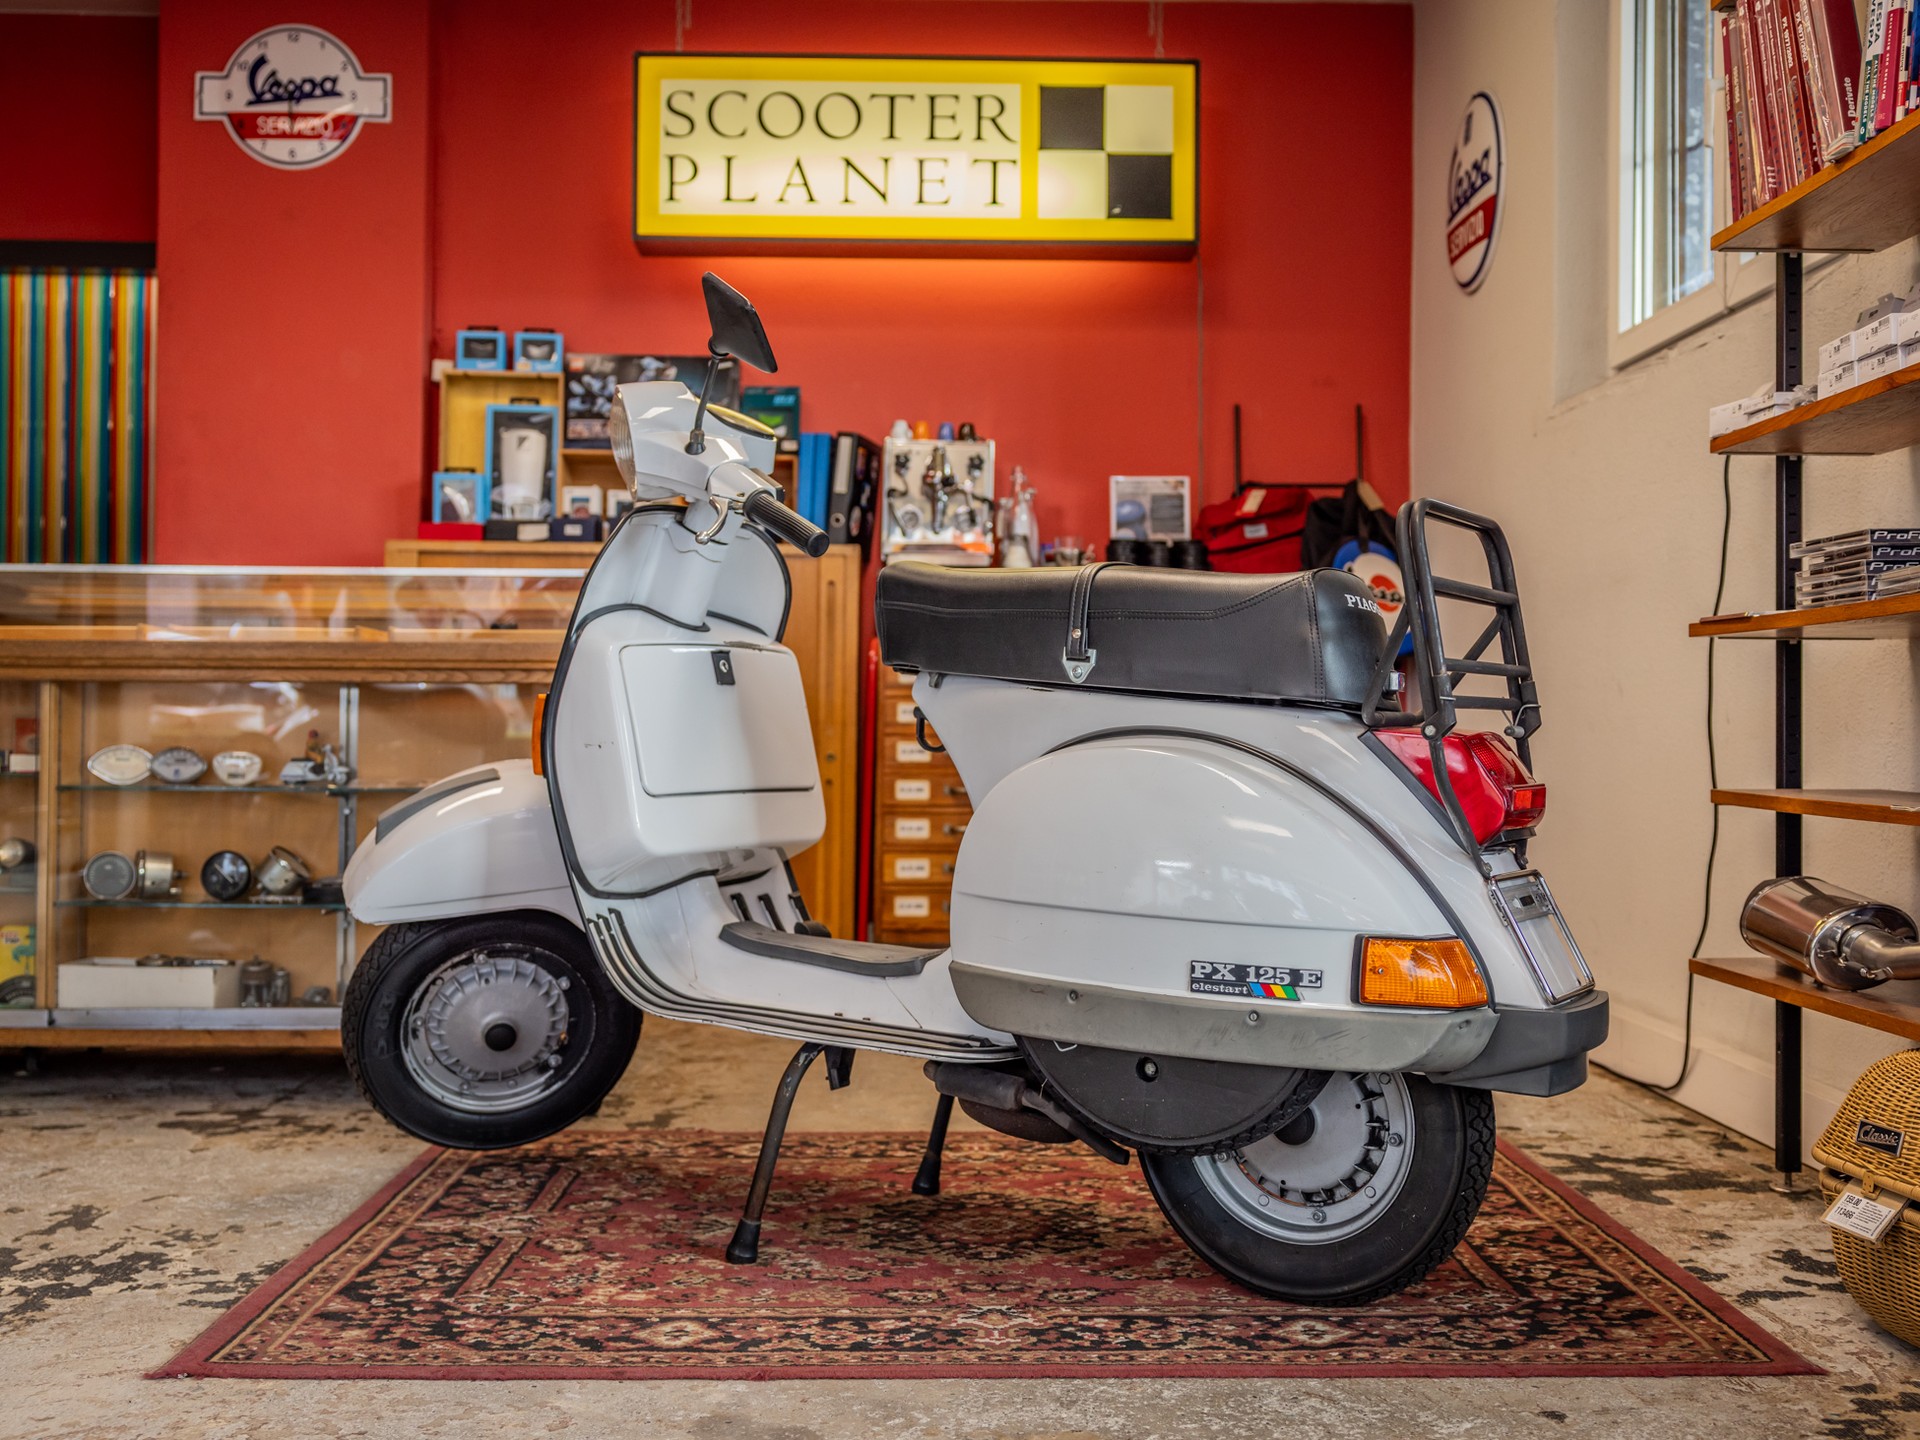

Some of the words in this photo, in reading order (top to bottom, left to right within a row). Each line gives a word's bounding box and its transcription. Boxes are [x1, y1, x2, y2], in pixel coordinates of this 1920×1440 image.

[246, 53, 344, 106] Vespa
[1843, 77, 1856, 117] Derivate
[664, 91, 1017, 144] SCOOTER
[664, 154, 1018, 208] PLANET
[1873, 531, 1920, 540] ProF
[1344, 593, 1382, 616] PIAG
[1191, 961, 1237, 981] PX
[1246, 966, 1291, 985] 125
[1299, 970, 1322, 987] E
[1192, 982, 1249, 995] elestart
[1858, 1125, 1900, 1146] Classic
[1844, 1193, 1863, 1208] 159.00
